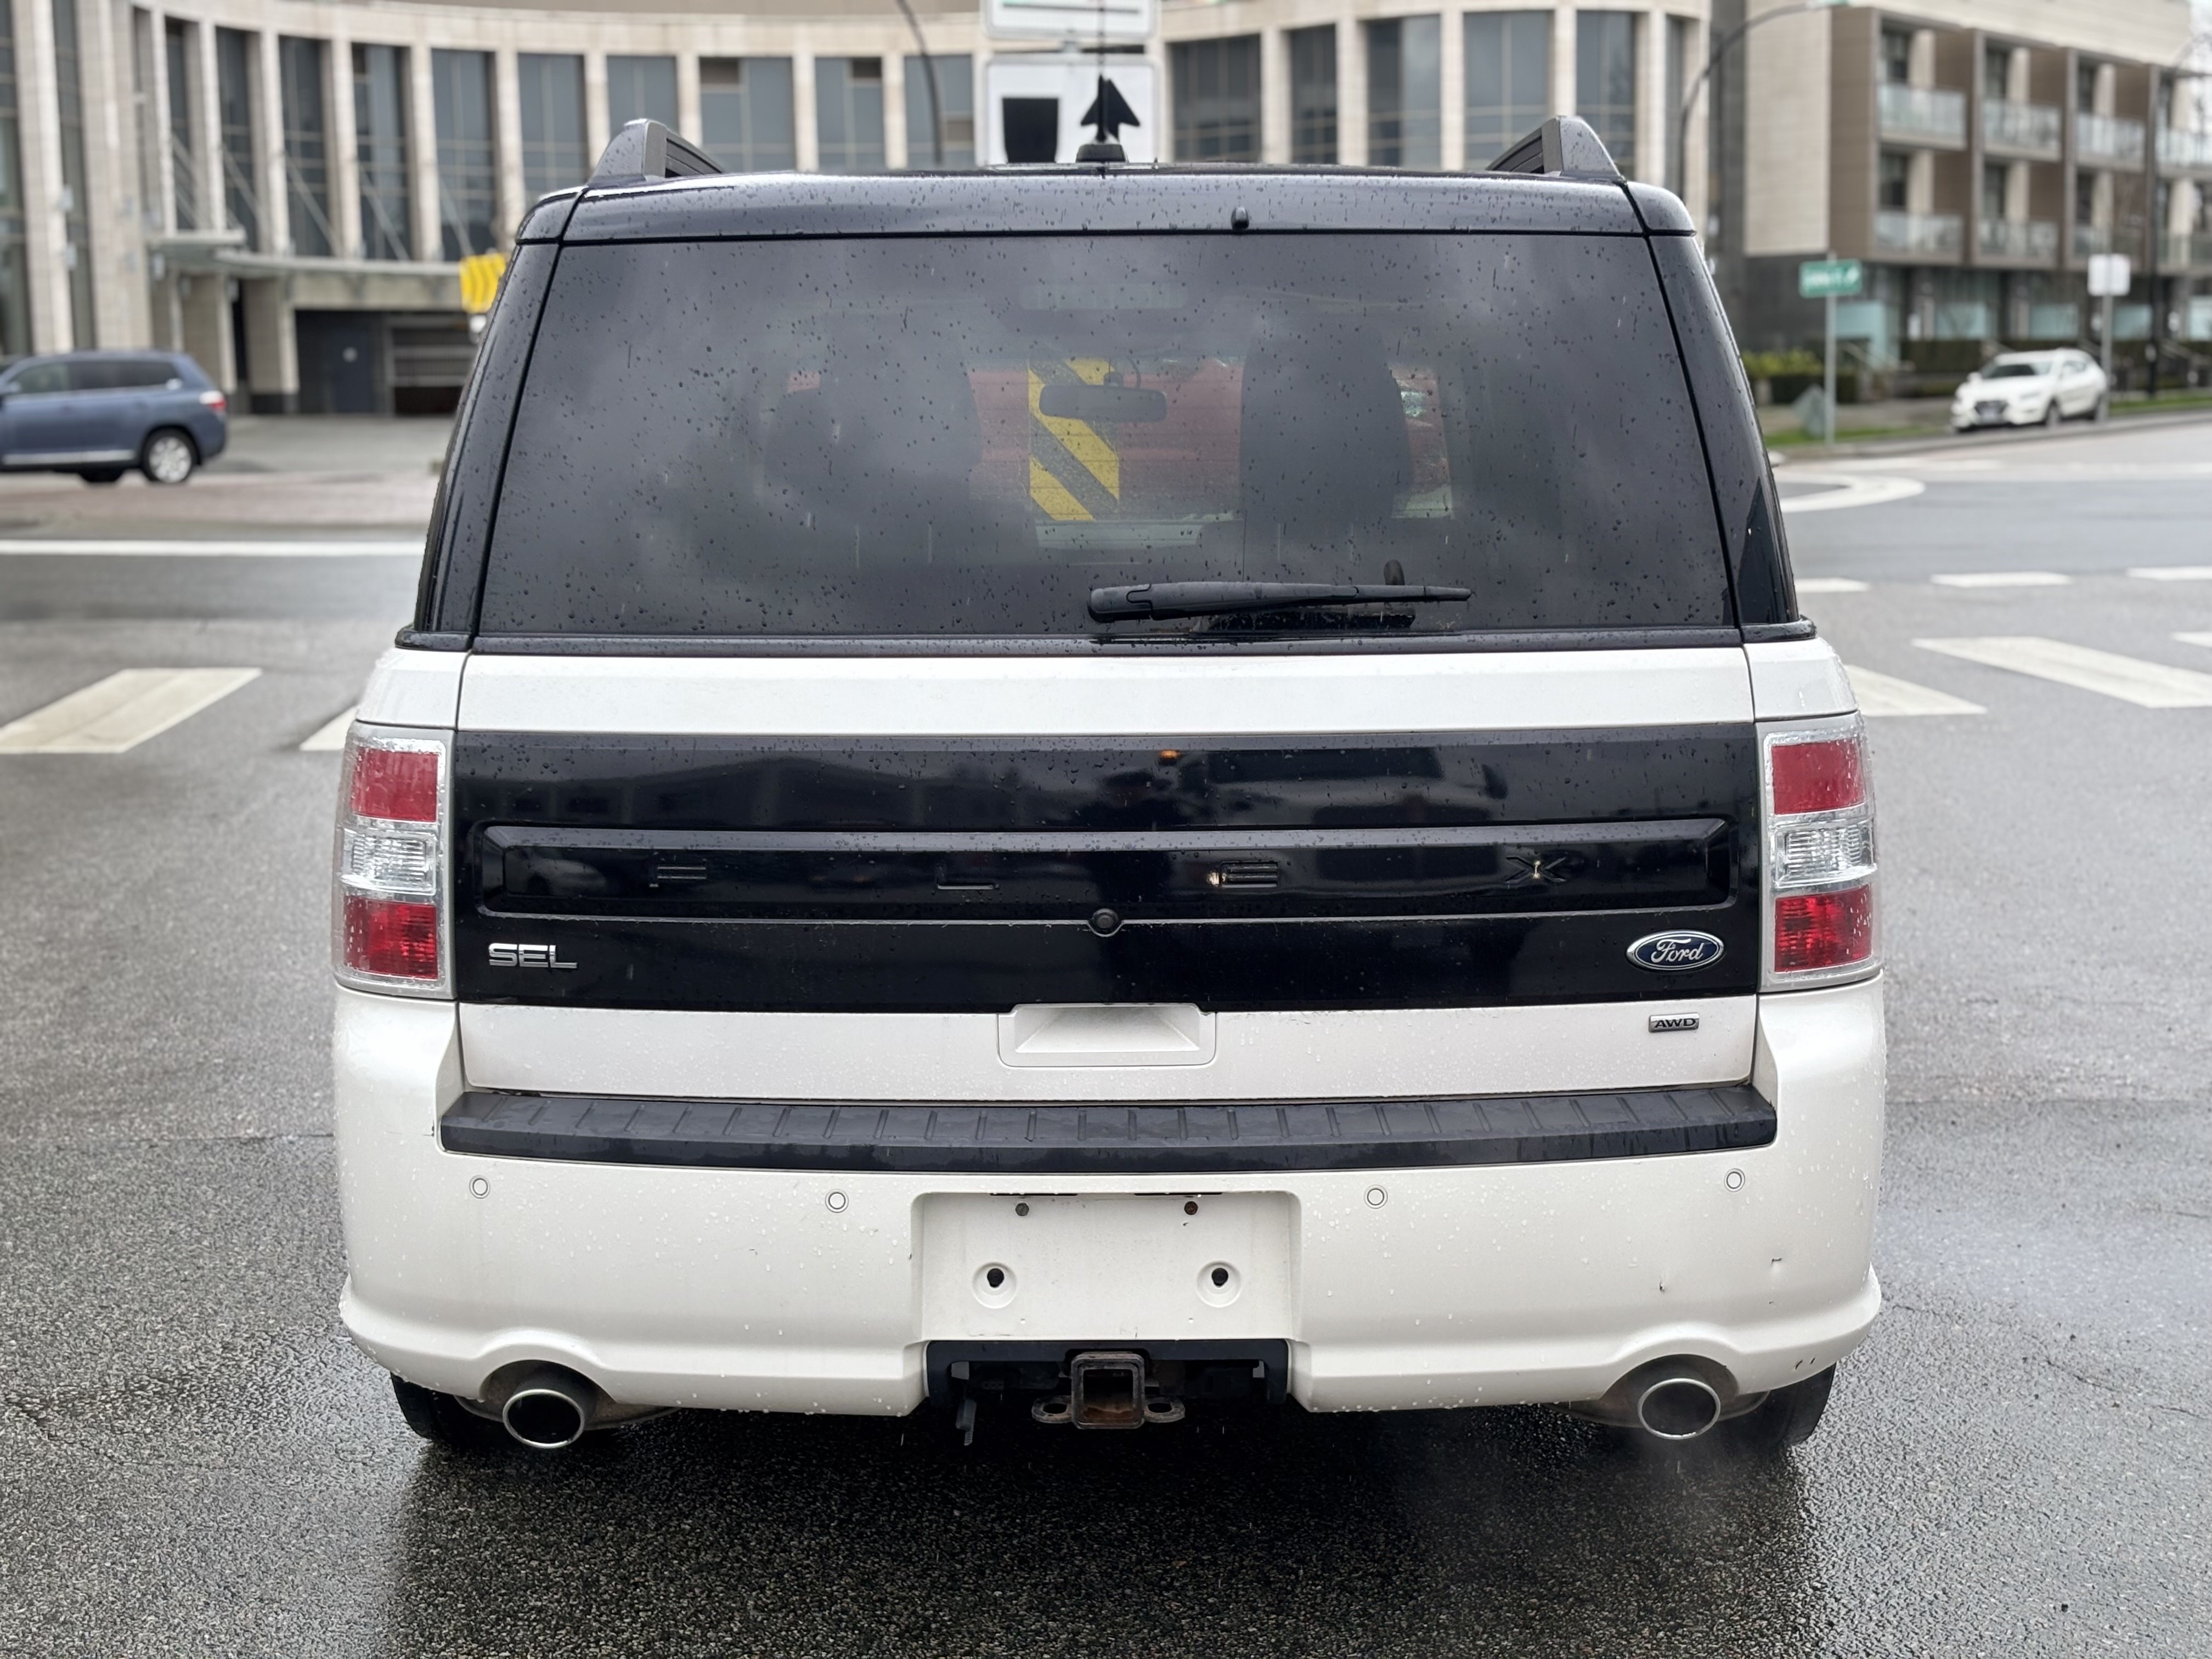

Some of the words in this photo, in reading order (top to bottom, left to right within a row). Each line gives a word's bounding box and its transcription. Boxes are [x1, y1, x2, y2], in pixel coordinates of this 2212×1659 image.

[488, 943, 578, 969] SEL
[1651, 938, 1704, 963] Ford
[1654, 1018, 1696, 1028] AWD
